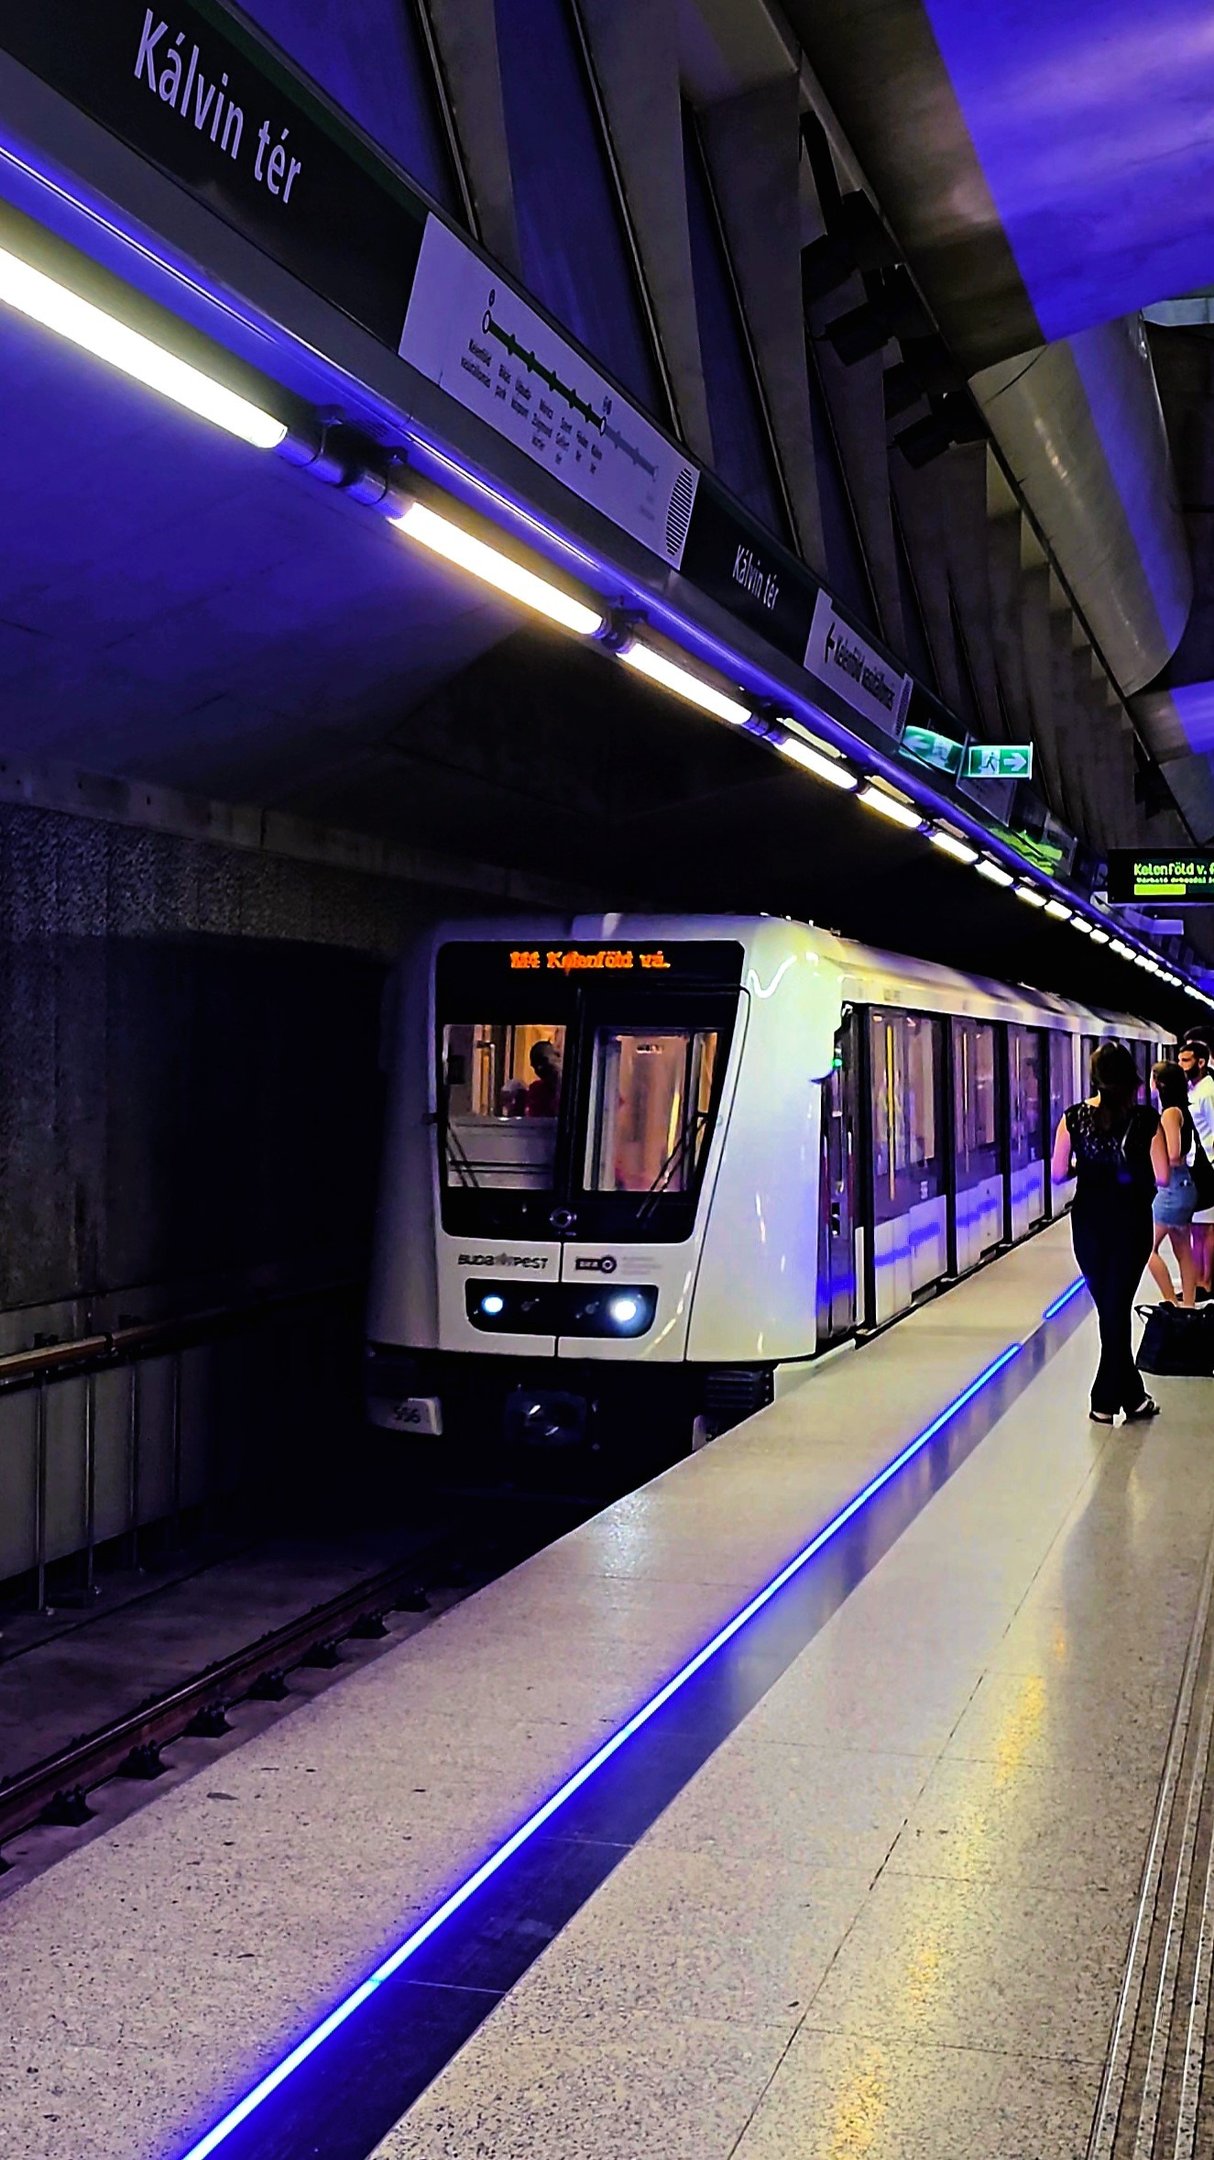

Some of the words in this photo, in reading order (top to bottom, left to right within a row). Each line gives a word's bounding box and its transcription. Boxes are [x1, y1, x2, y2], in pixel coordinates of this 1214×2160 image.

[134, 8, 244, 160] Kálvin
[254, 120, 302, 204] tér
[732, 544, 763, 599] Kálvin
[763, 573, 779, 610] tér
[546, 951, 634, 969] Kelenföld
